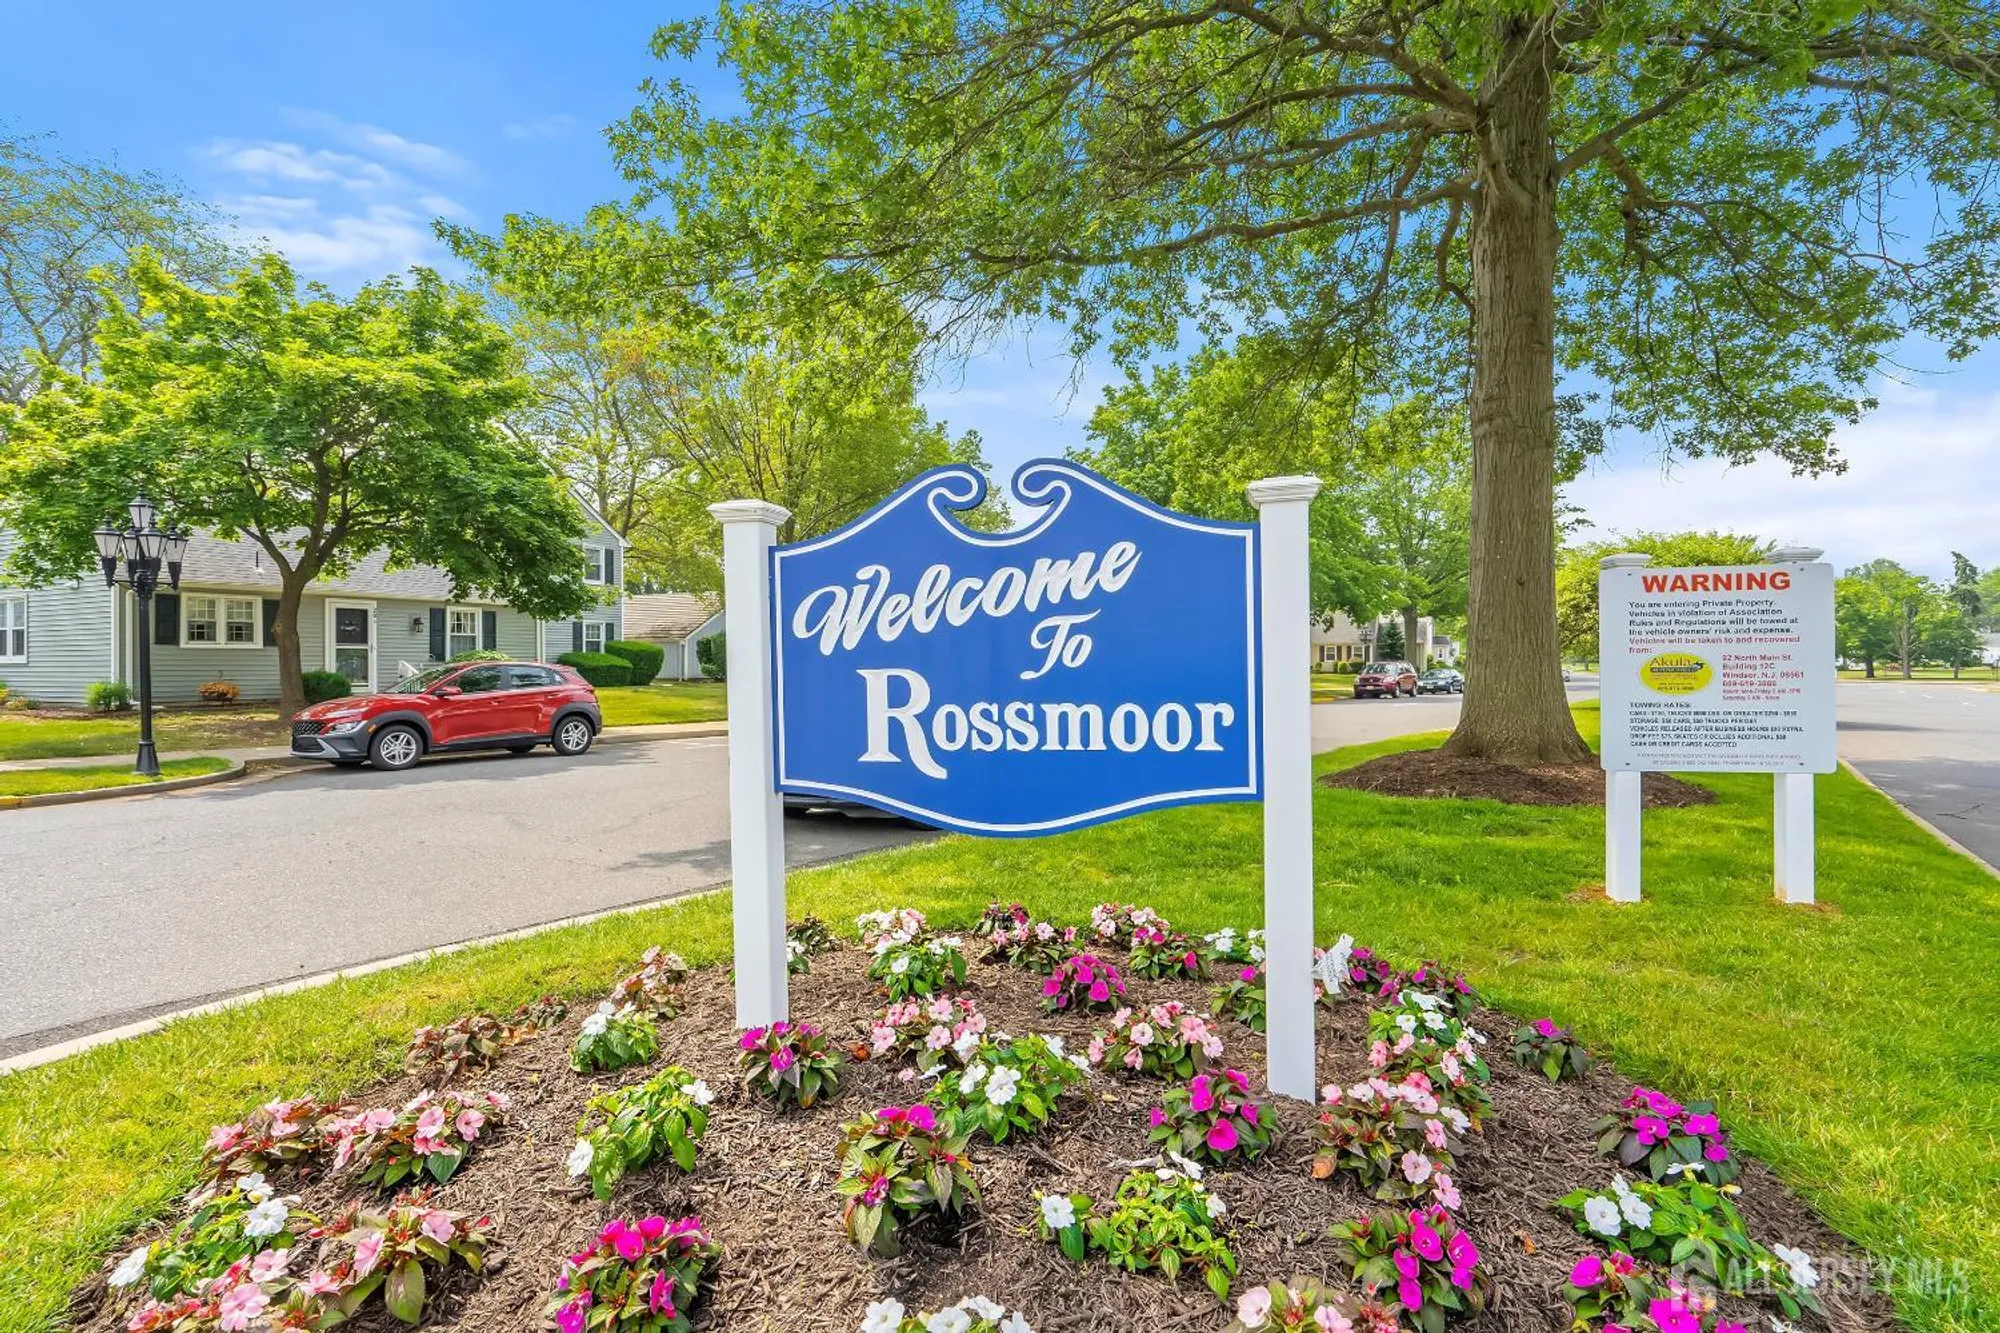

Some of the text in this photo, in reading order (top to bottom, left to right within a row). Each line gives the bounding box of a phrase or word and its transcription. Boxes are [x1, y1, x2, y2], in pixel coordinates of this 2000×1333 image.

[1641, 571, 1791, 593] WARNING
[791, 540, 1143, 657] Welcome
[1664, 600, 1700, 609] entering
[1729, 608, 1783, 616] Association
[1674, 618, 1727, 627] Regulations
[1645, 628, 1676, 636] vehicle
[1019, 608, 1102, 681] To
[1629, 637, 1665, 645] Vehicles
[1698, 636, 1722, 644] taken
[1754, 635, 1801, 643] recovered
[1629, 646, 1652, 654] from:
[1649, 657, 1691, 667] Akula
[1722, 662, 1757, 671] Building
[855, 667, 1235, 780] Rossmoor
